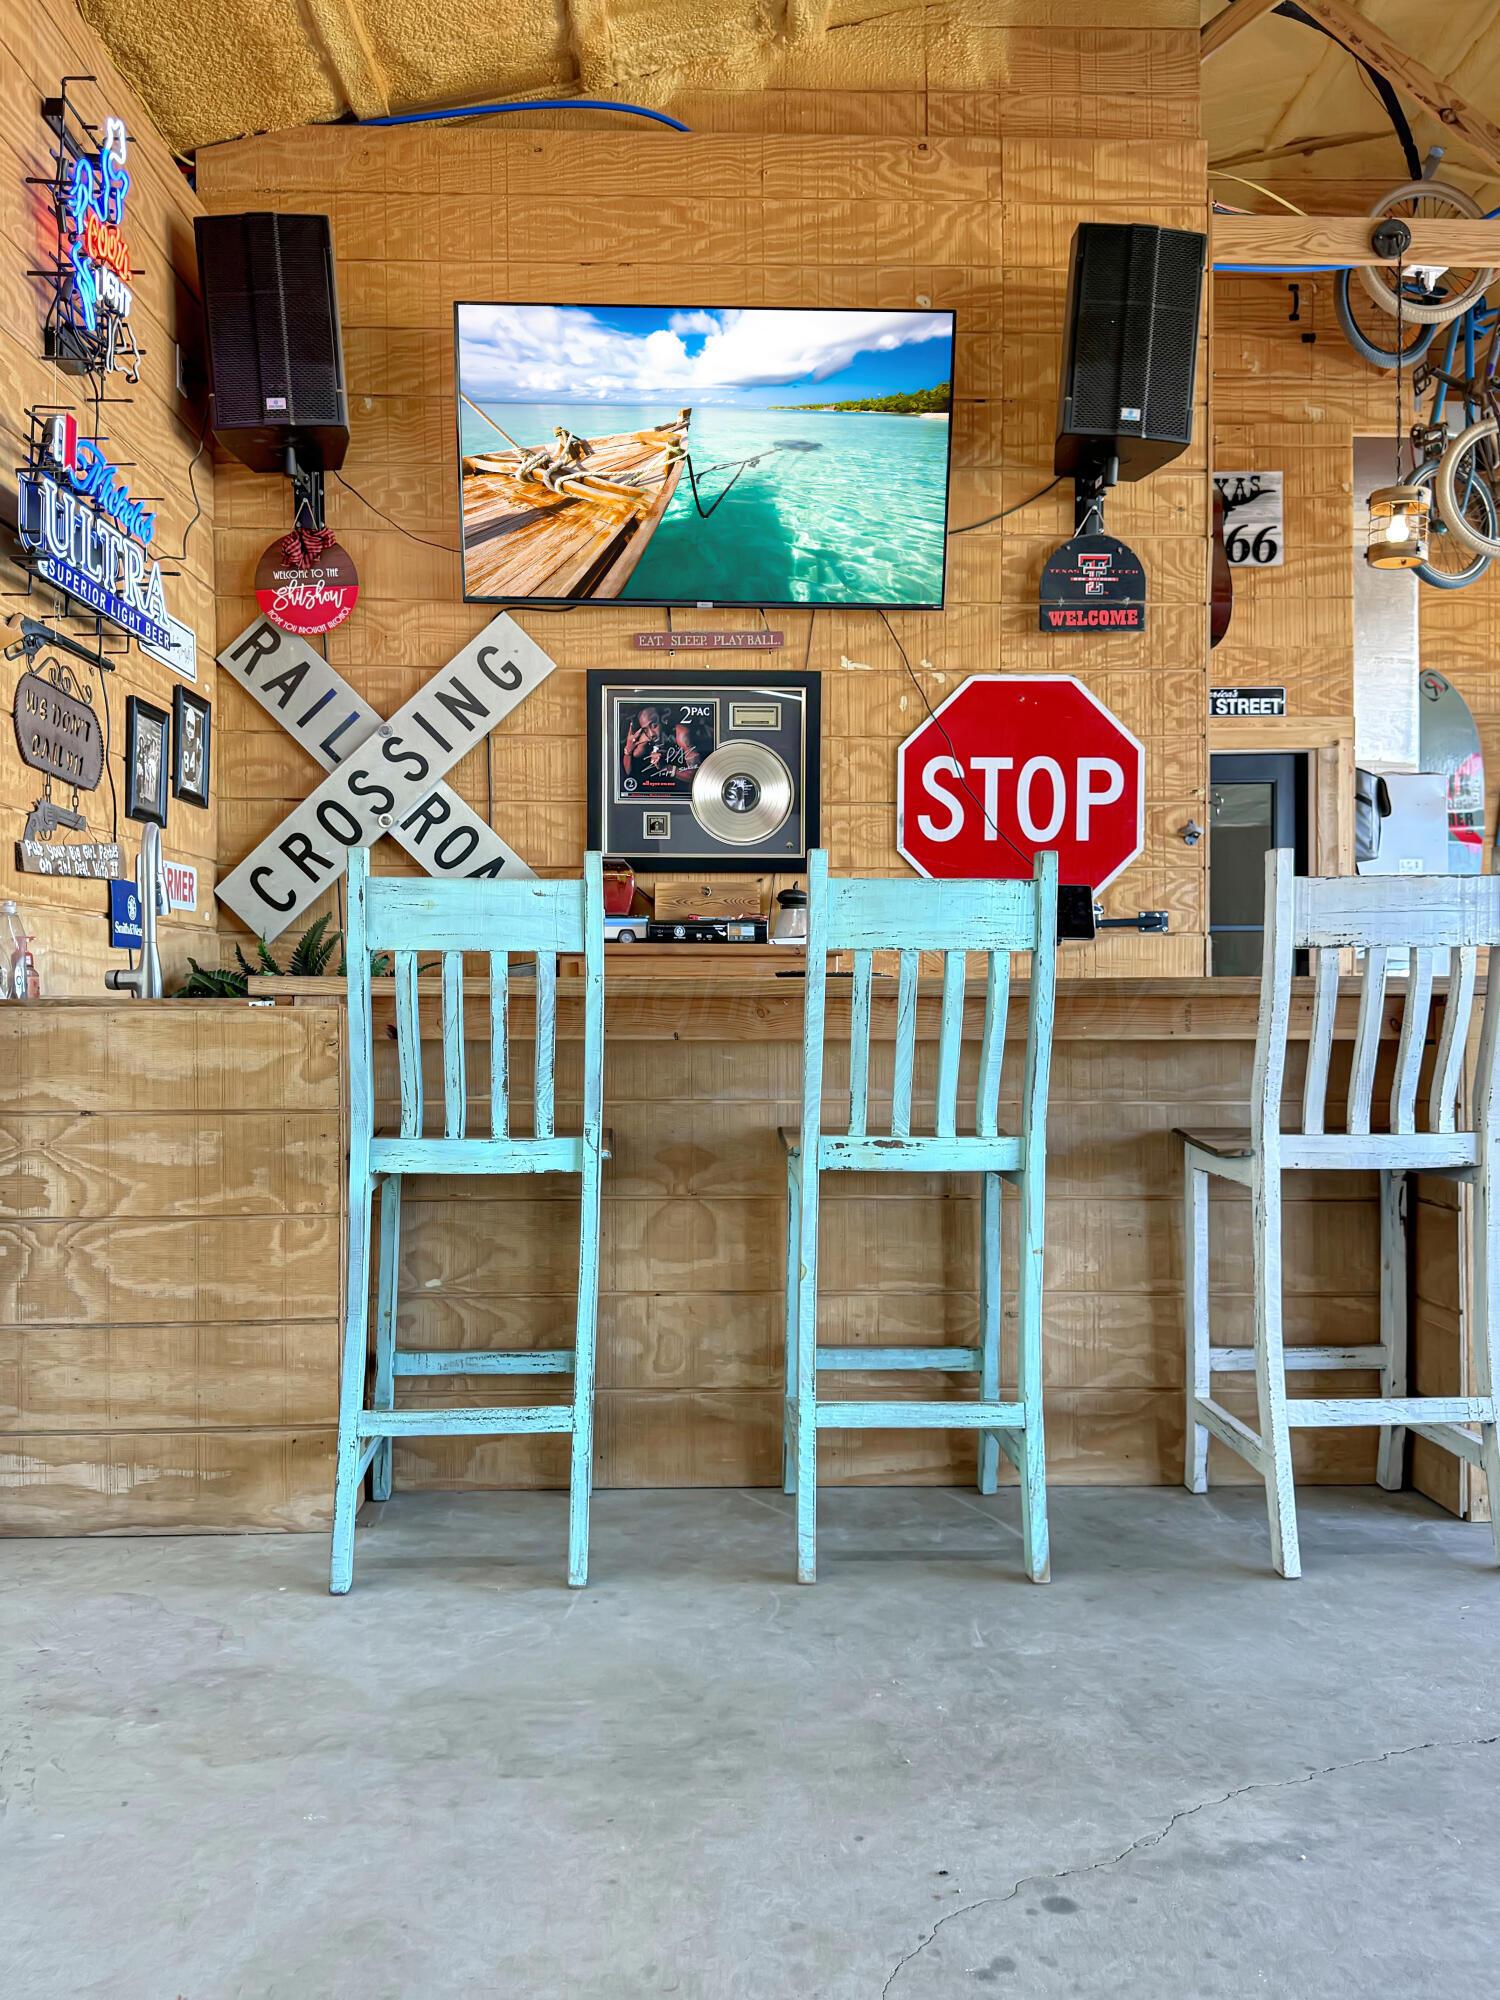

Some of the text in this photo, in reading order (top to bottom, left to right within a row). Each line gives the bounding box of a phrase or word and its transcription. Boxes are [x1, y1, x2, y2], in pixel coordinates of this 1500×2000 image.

[95, 265, 132, 318] LIGHT
[67, 438, 157, 544] Michelob
[43, 478, 170, 628] ULTRA
[1225, 524, 1278, 563] 66
[272, 567, 339, 580] WELCOME TO THE
[48, 558, 170, 650] SUPERIOR LIGHT BEER
[271, 579, 347, 611] Shitshow
[266, 609, 284, 626] HOPE
[282, 620, 297, 632] YOU
[1048, 609, 1138, 626] WELCOME
[639, 634, 781, 646] EAT. SLEEP. PLAY BALL.
[25, 688, 48, 721] WE
[230, 621, 360, 764] RAIL
[1215, 698, 1282, 715] STREET
[679, 705, 710, 724] 2PAC
[32, 734, 62, 768] CALL
[183, 750, 196, 773] 84
[249, 645, 523, 912] CROSSING
[917, 755, 1125, 843] STOP
